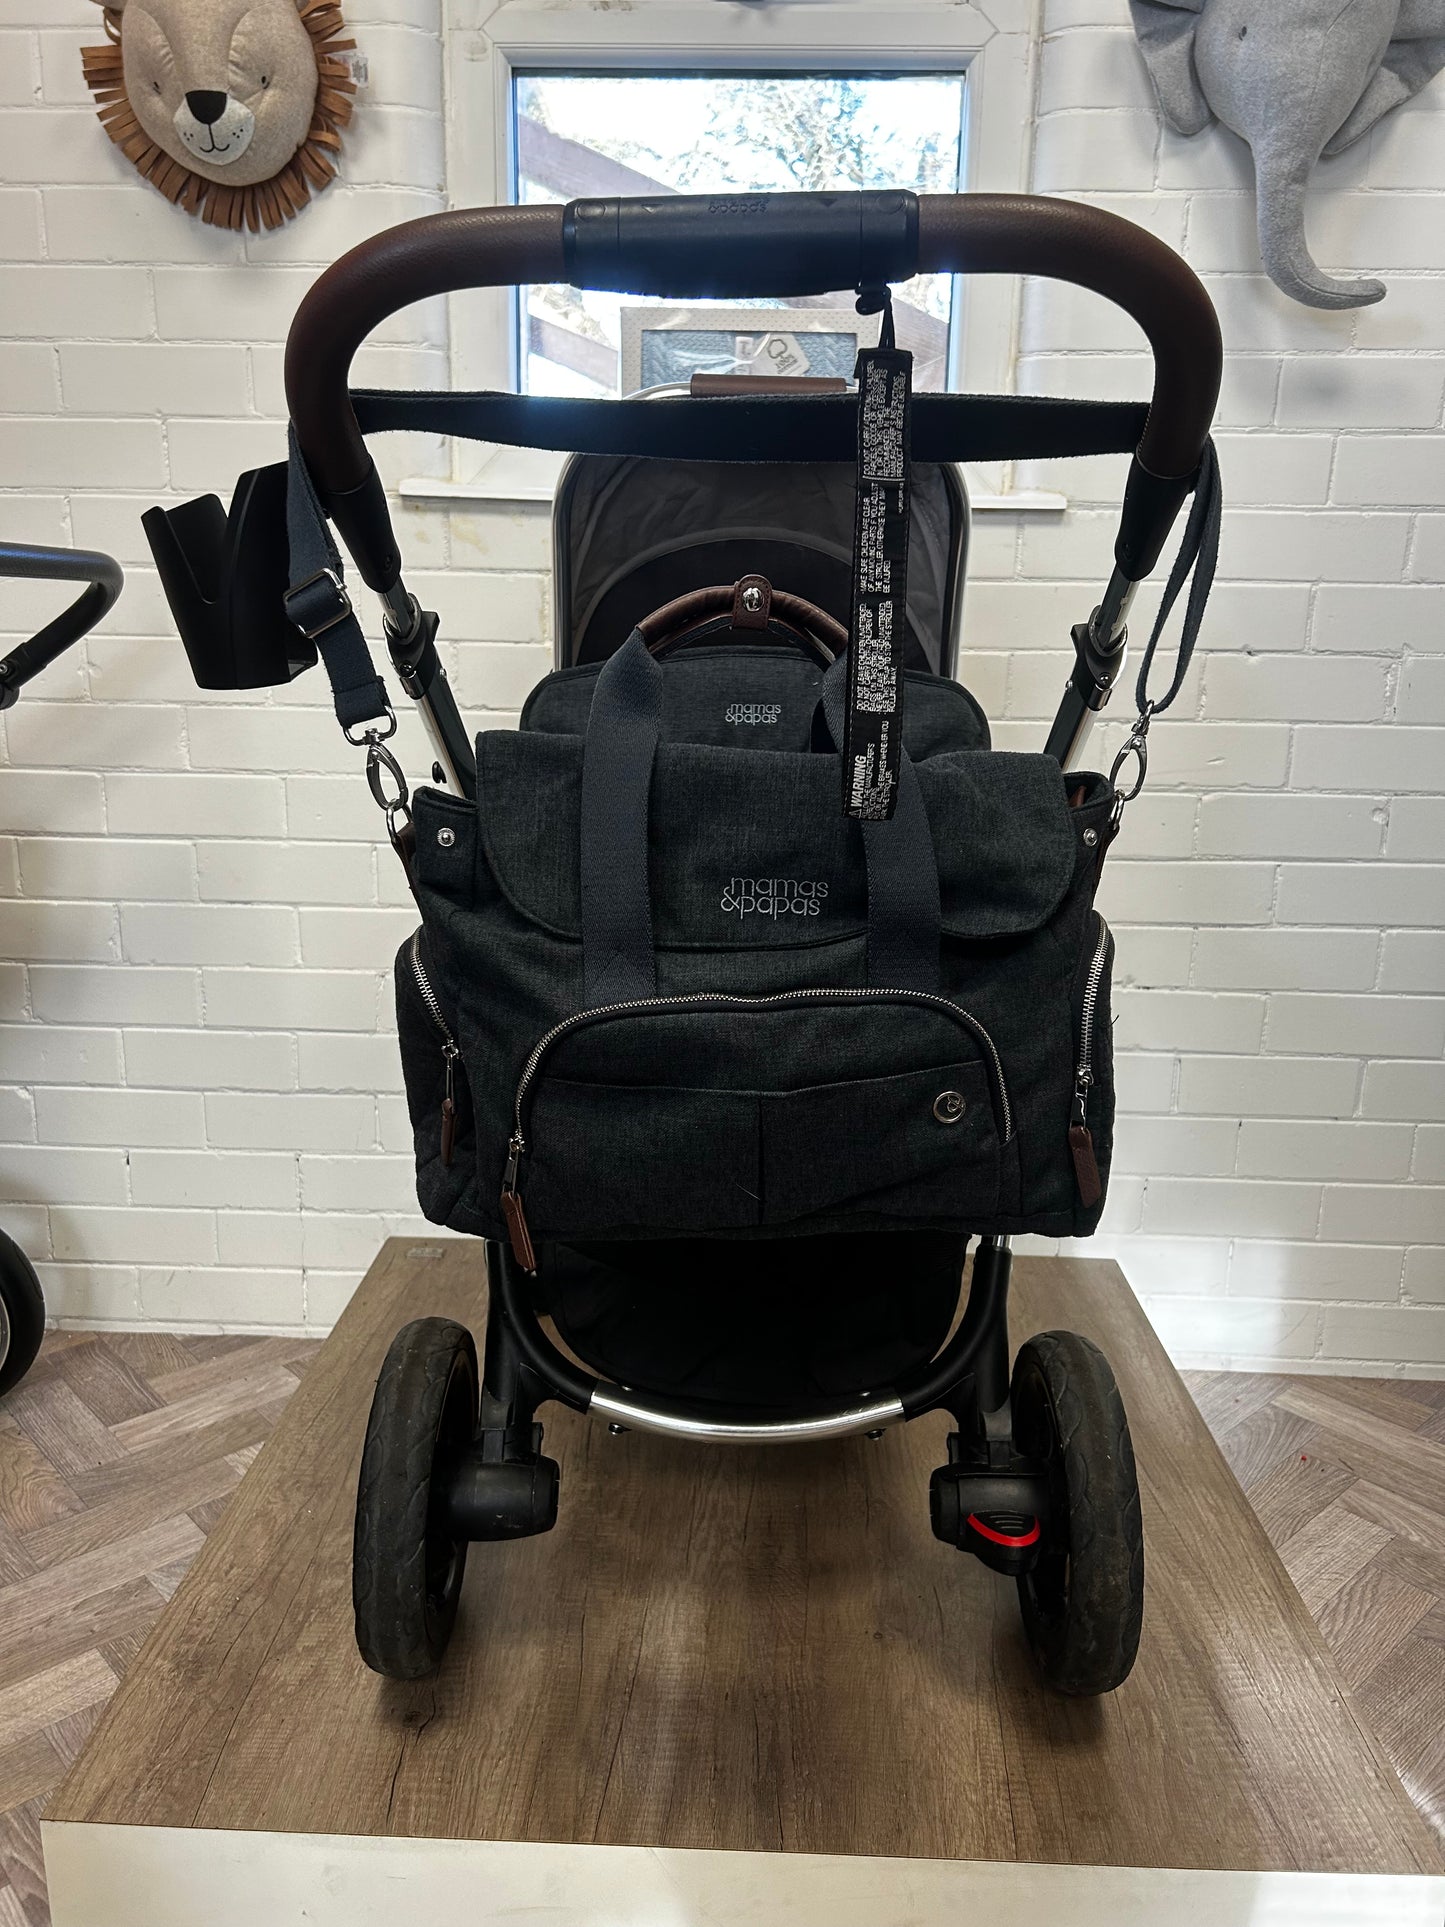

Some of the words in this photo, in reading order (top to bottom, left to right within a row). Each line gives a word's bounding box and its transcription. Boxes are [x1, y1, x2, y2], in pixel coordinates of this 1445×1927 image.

[877, 405, 885, 429] VEHICLE
[897, 403, 905, 429] BECOME
[863, 425, 871, 448] CARRY
[870, 423, 878, 446] GOODS
[878, 501, 886, 517] THEY
[861, 531, 869, 557] CHILDREN
[869, 526, 877, 545] PARTS
[877, 518, 886, 550] OTHERWISE
[725, 708, 778, 726] &papas
[730, 703, 782, 714] mamas
[851, 755, 866, 807] WARNING
[878, 761, 887, 782] BRAKES
[731, 877, 829, 898] mamas
[720, 886, 820, 921] &papas
